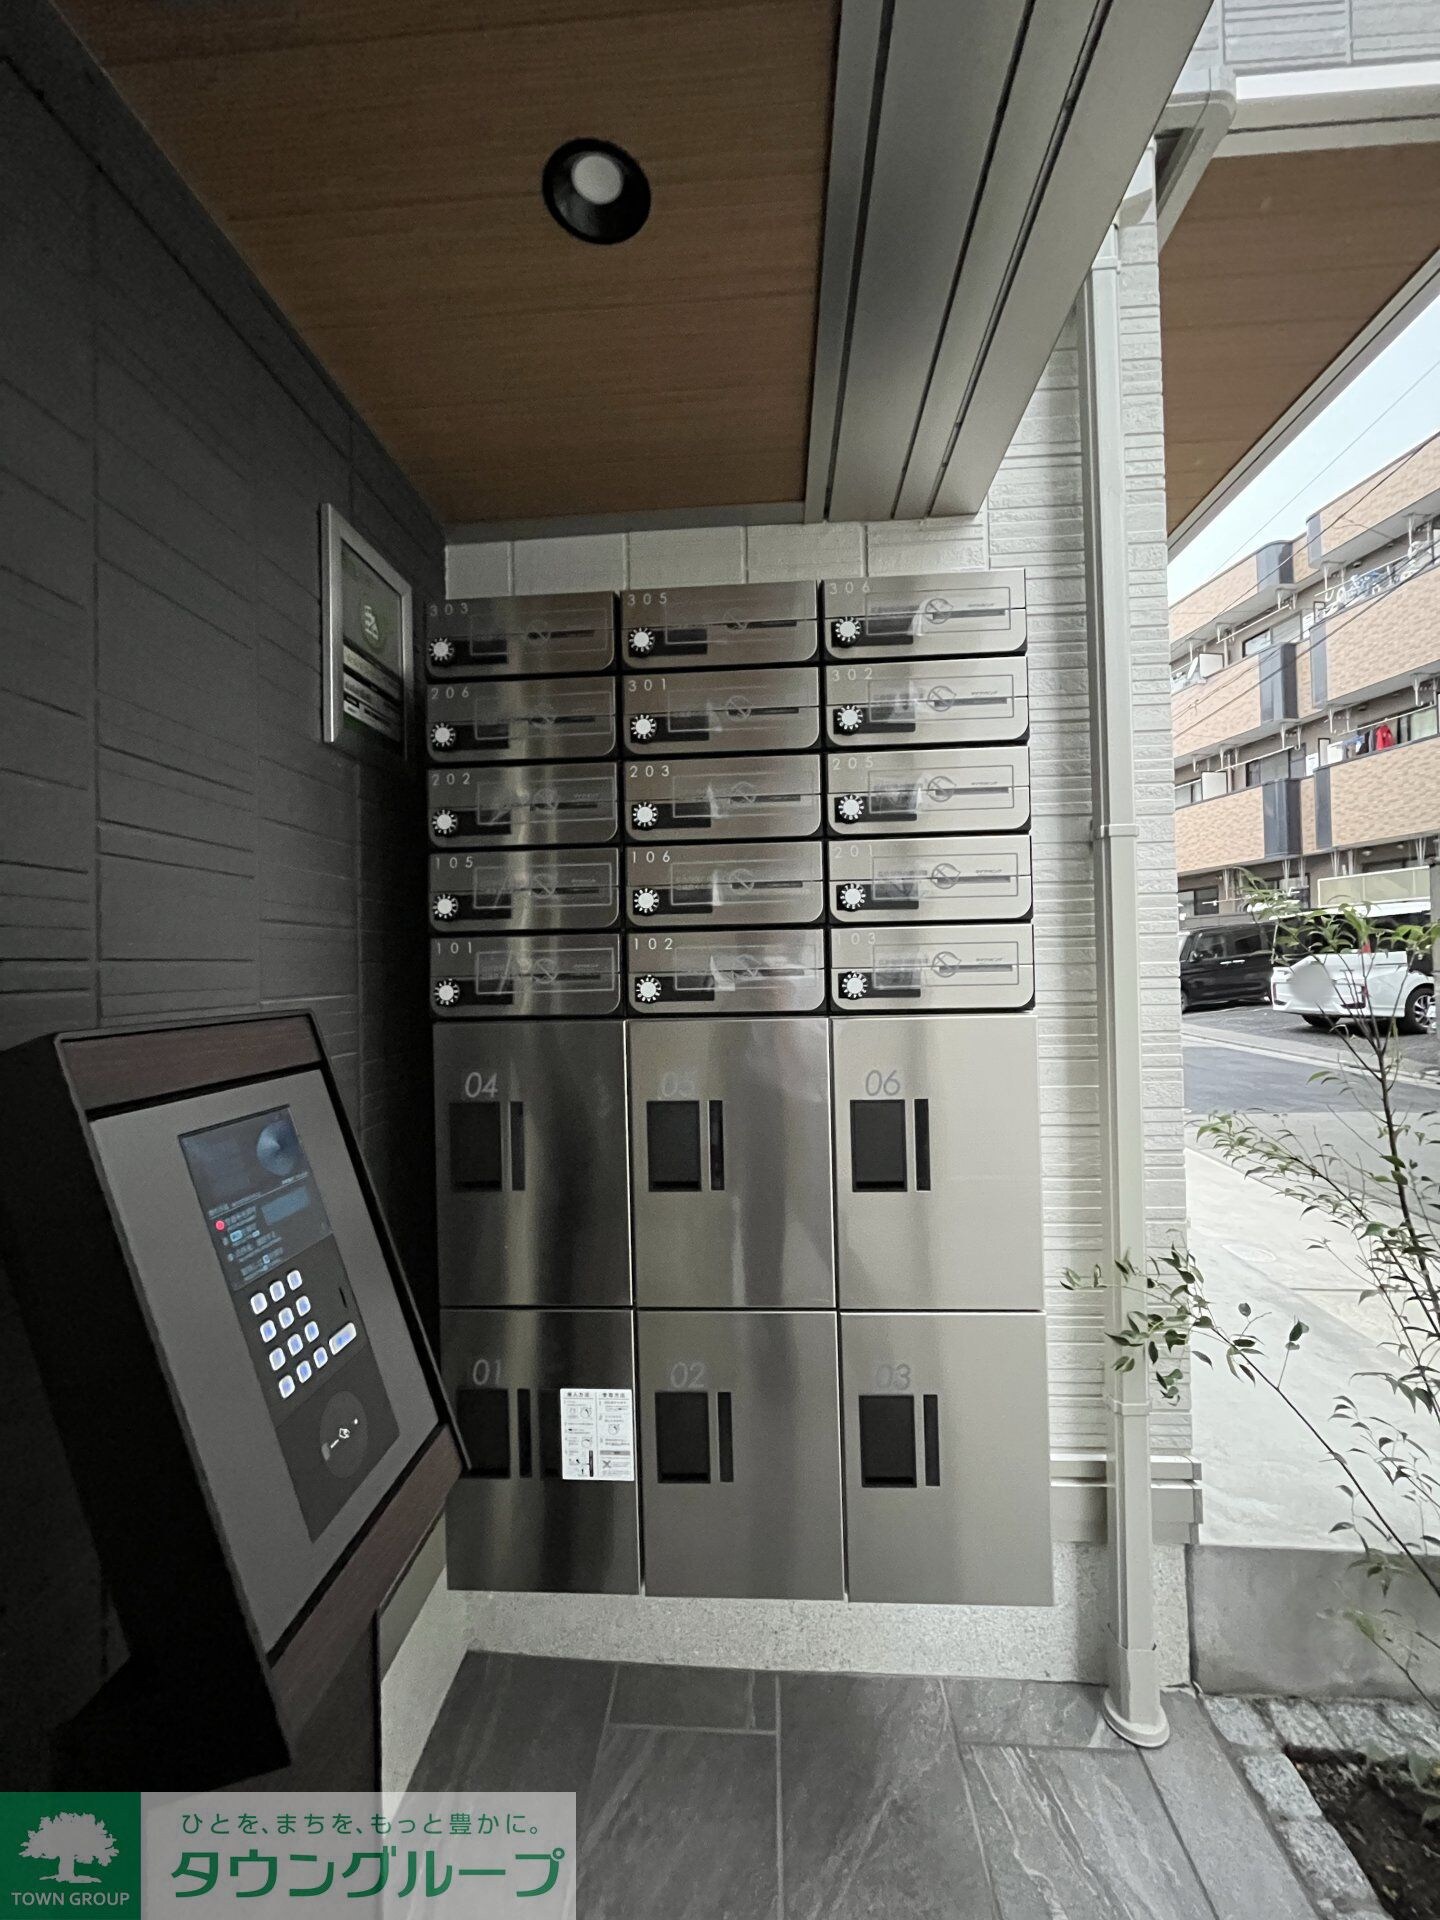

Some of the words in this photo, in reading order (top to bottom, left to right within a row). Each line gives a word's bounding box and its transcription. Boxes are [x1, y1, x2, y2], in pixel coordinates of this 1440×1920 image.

[829, 580, 871, 595] 306
[627, 592, 668, 606] 305
[429, 602, 469, 617] 303
[831, 667, 873, 682] 302
[628, 677, 667, 692] 301
[430, 686, 470, 700] 206
[831, 755, 874, 771] 205
[432, 772, 471, 786] 202
[629, 765, 670, 778] 203
[631, 850, 671, 863] 106
[834, 843, 874, 858] 201
[435, 855, 474, 869] 105
[633, 937, 673, 950] 102
[835, 931, 876, 945] 103
[436, 941, 473, 954] 101
[464, 1071, 498, 1098] 04
[865, 1069, 901, 1097] 06
[472, 1358, 501, 1386] 01
[669, 1361, 705, 1388] 02
[875, 1362, 911, 1390] 03
